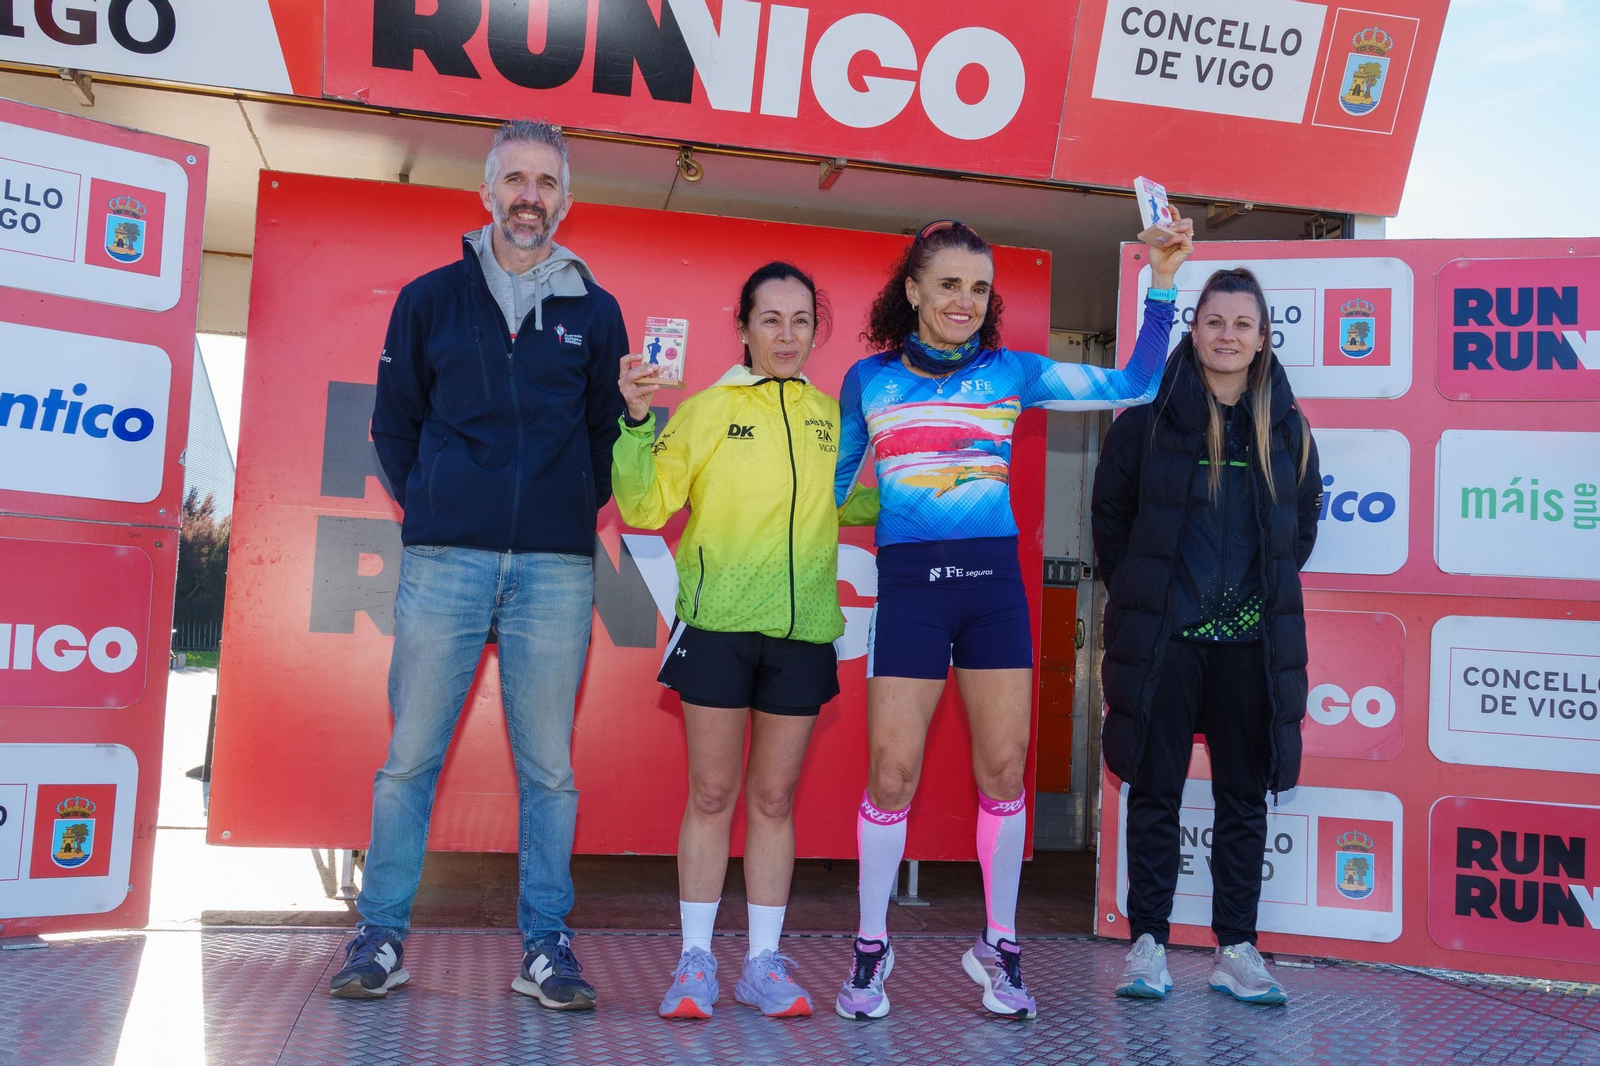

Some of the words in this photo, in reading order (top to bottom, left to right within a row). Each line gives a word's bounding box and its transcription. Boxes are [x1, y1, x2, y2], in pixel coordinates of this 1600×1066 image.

[1121, 6, 1302, 56] CONCELLO
[1135, 47, 1181, 80] DE
[1195, 54, 1274, 91] VIGO
[1453, 286, 1579, 327] RUN
[728, 423, 756, 437] DK
[1461, 476, 1564, 522] máis
[1573, 483, 1600, 530] que
[944, 566, 964, 578] FE
[965, 569, 993, 578] seguros
[1463, 666, 1600, 694] CONCELL
[1481, 694, 1517, 715] DE
[1528, 697, 1598, 721] VIGO
[1456, 827, 1586, 879] RUN
